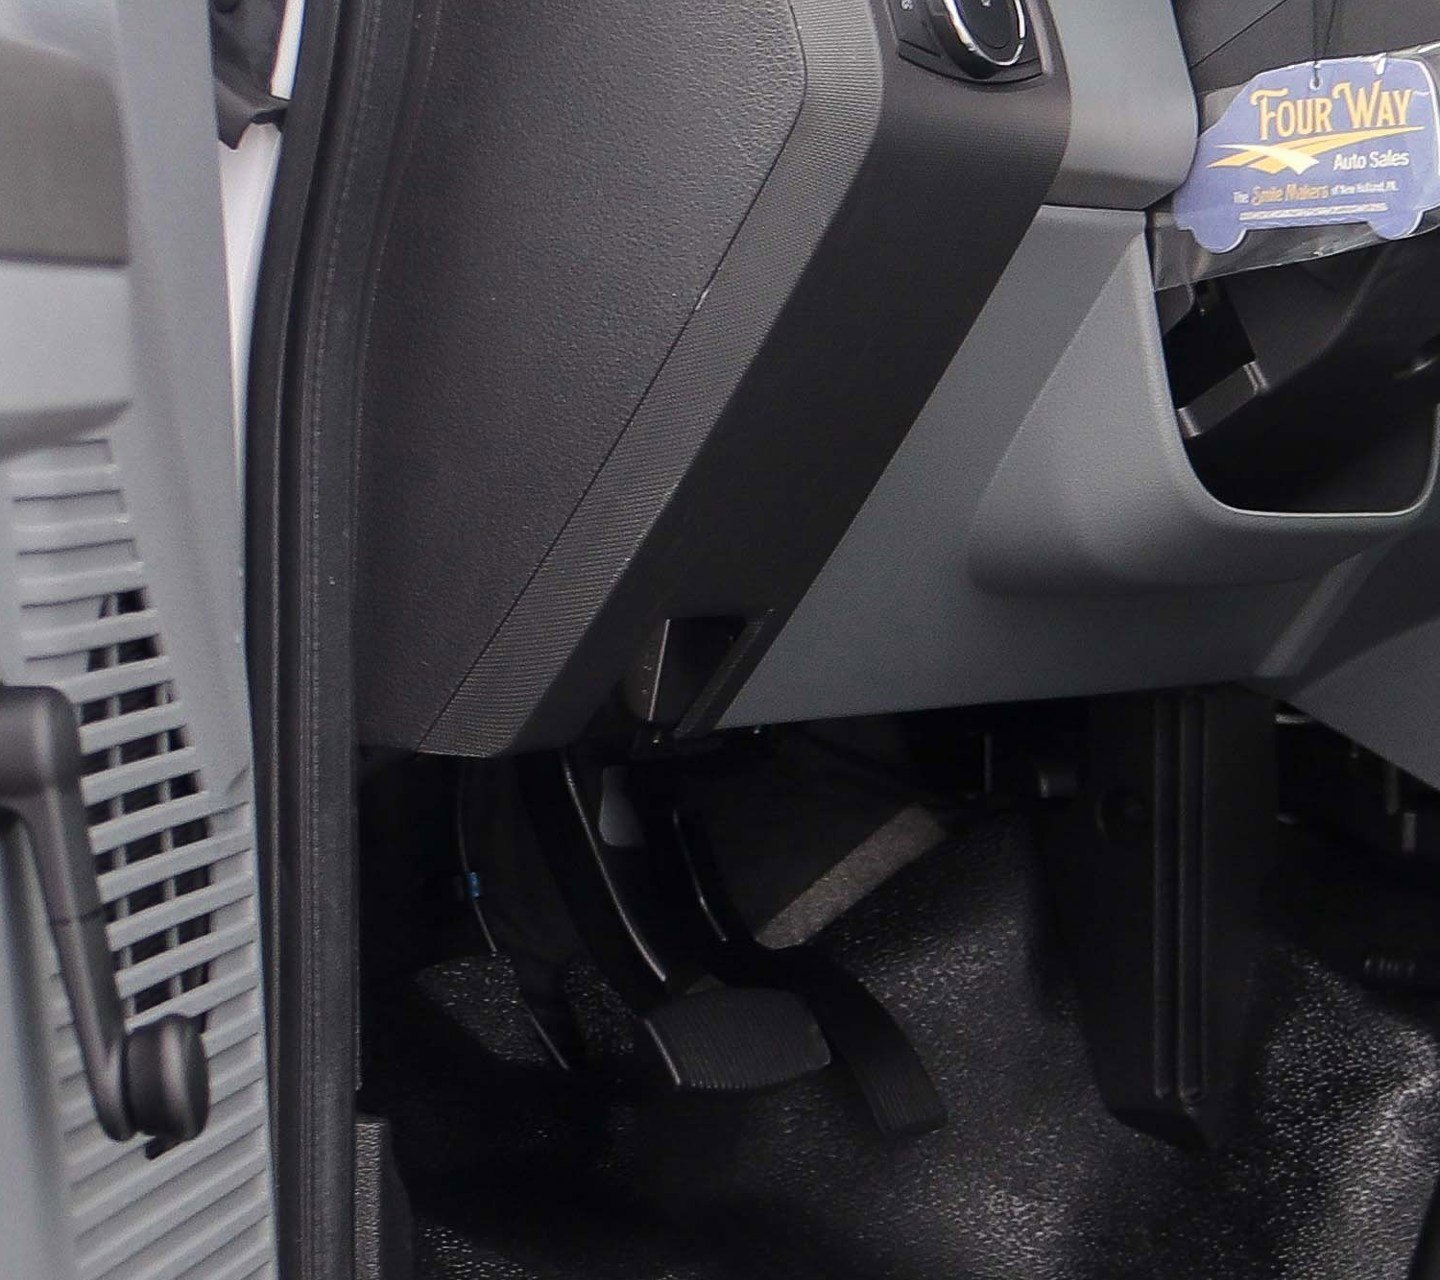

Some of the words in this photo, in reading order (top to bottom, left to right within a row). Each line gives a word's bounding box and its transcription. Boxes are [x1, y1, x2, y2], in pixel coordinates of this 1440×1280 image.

[1249, 86, 1334, 142] FOUR
[1331, 78, 1413, 131] WAY
[1333, 152, 1367, 171] Auto
[1369, 148, 1410, 168] Sales
